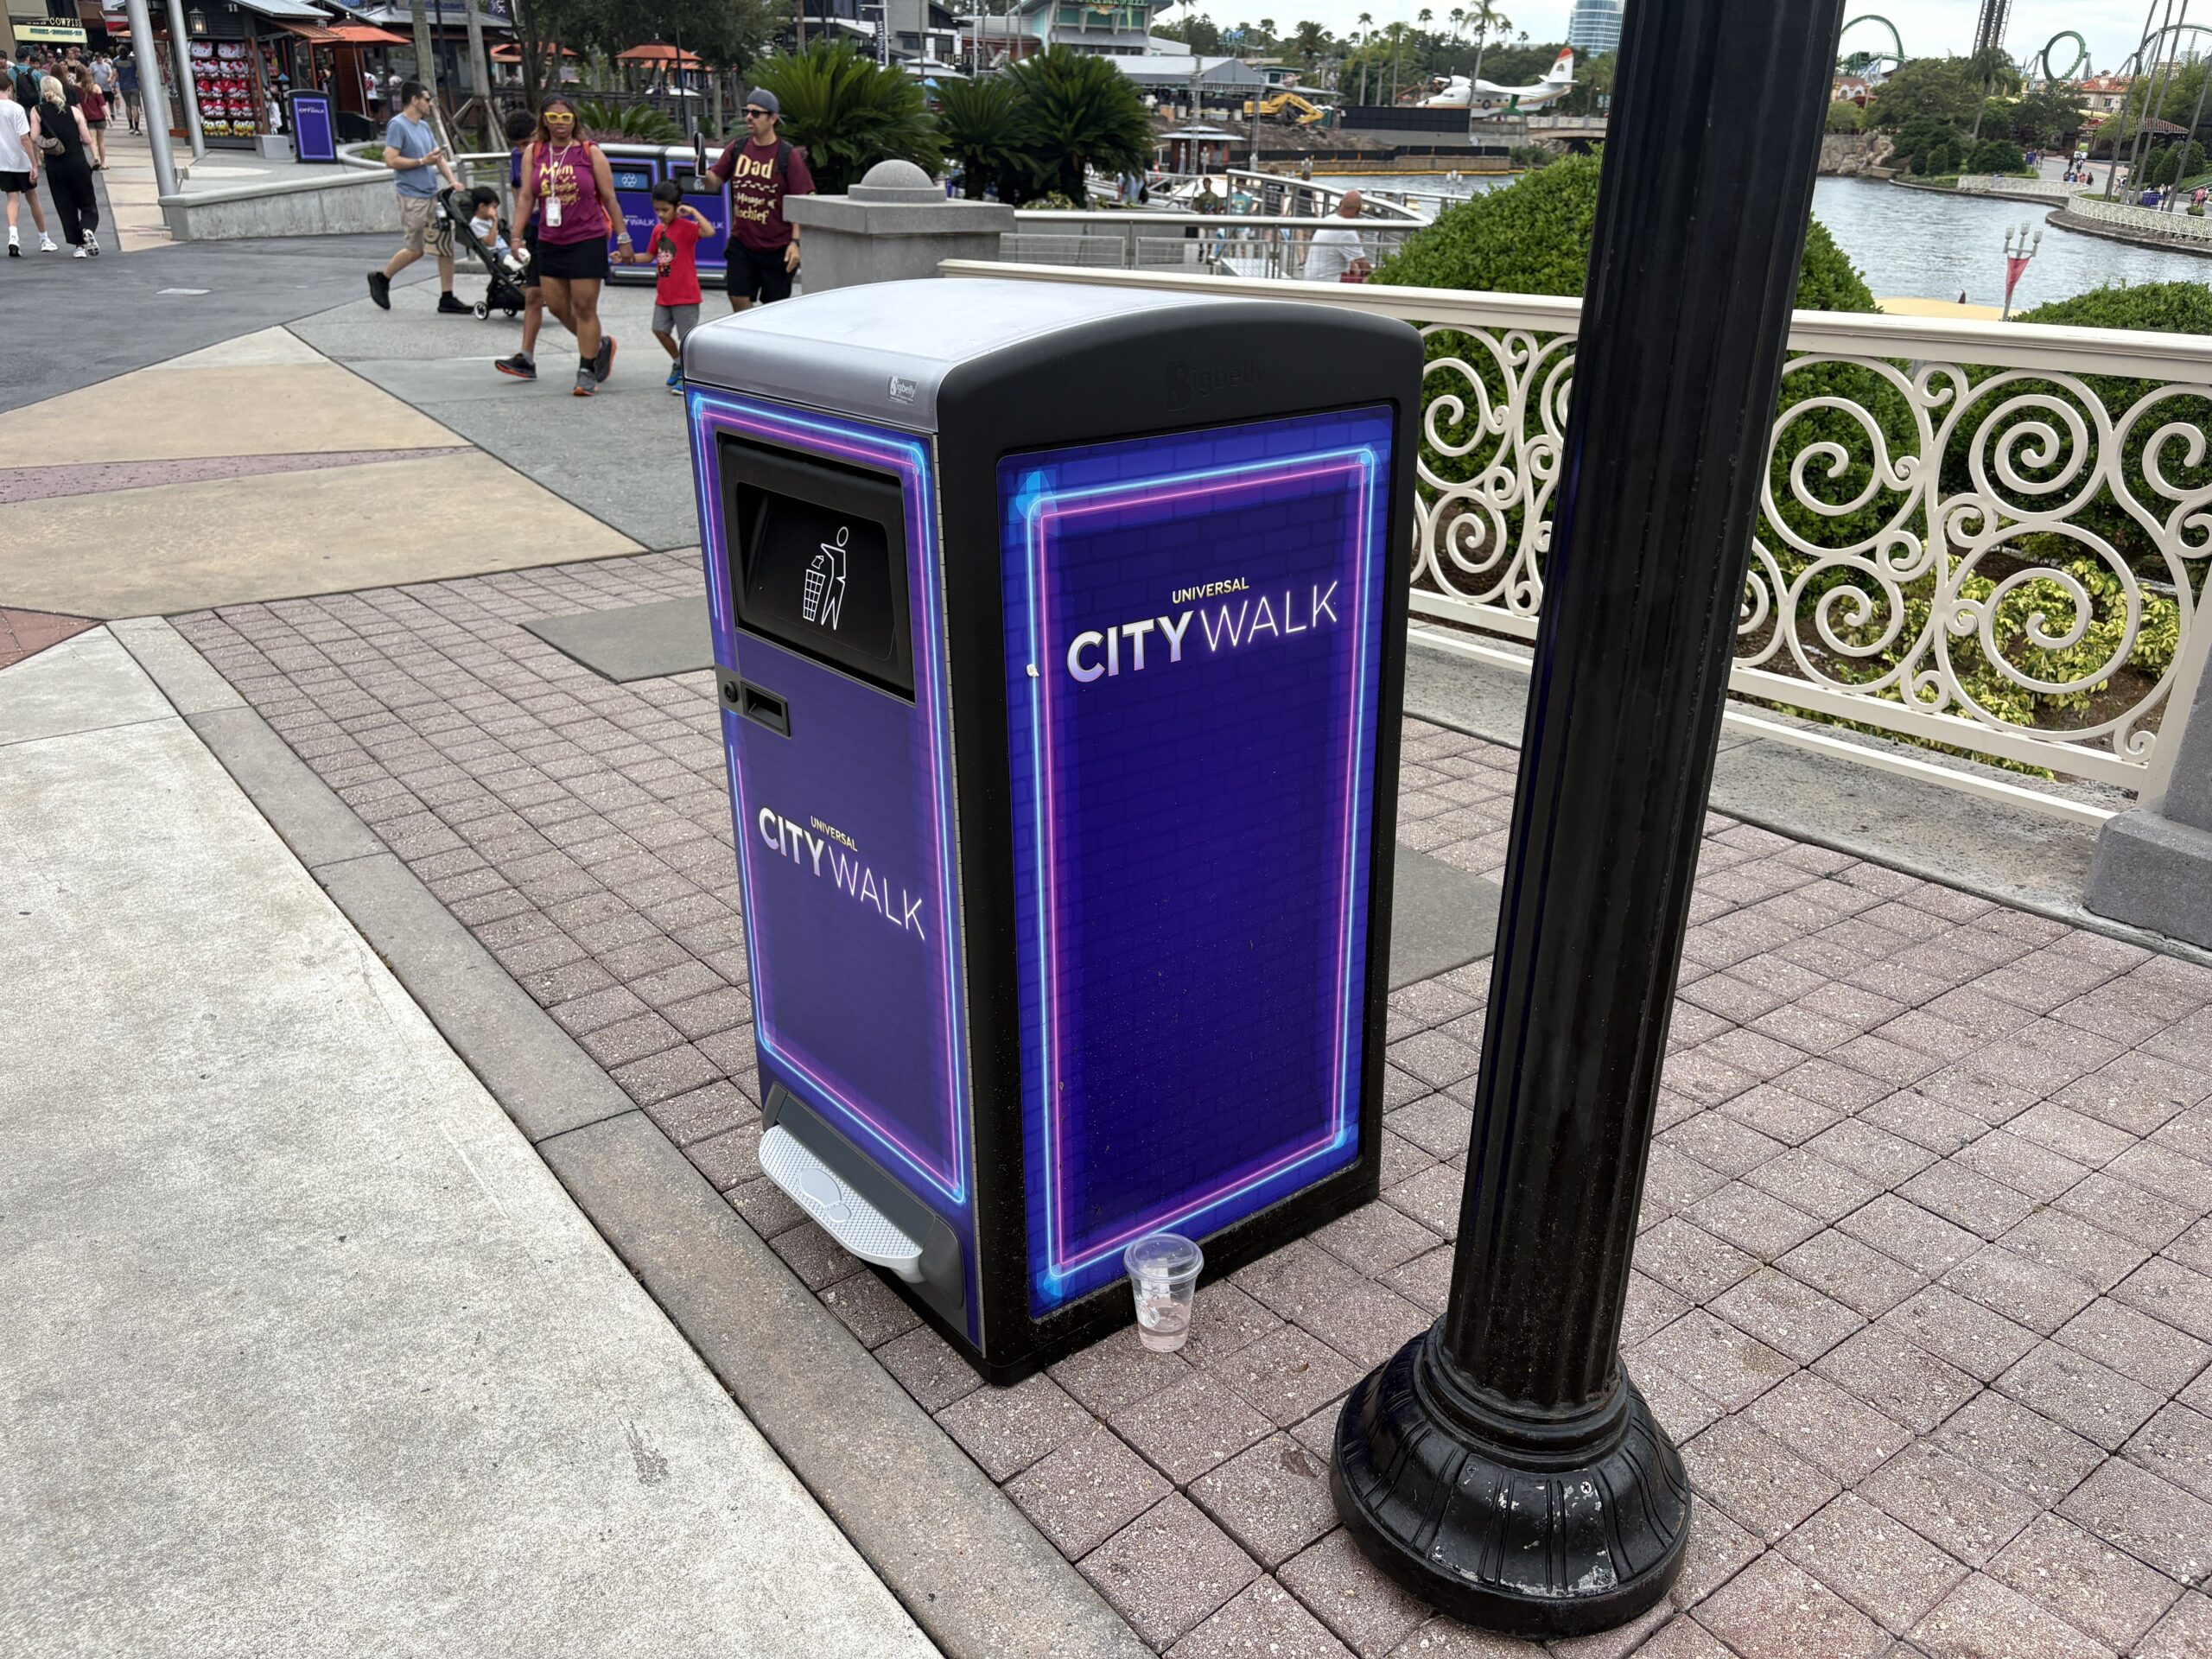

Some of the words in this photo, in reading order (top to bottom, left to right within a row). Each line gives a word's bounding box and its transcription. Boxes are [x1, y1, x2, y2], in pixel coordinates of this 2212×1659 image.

[734, 154, 774, 180] Dad
[890, 376, 916, 398] Bigbelly
[1173, 576, 1249, 604] UNIVERSAL
[810, 815, 858, 852] UNIVERSAL
